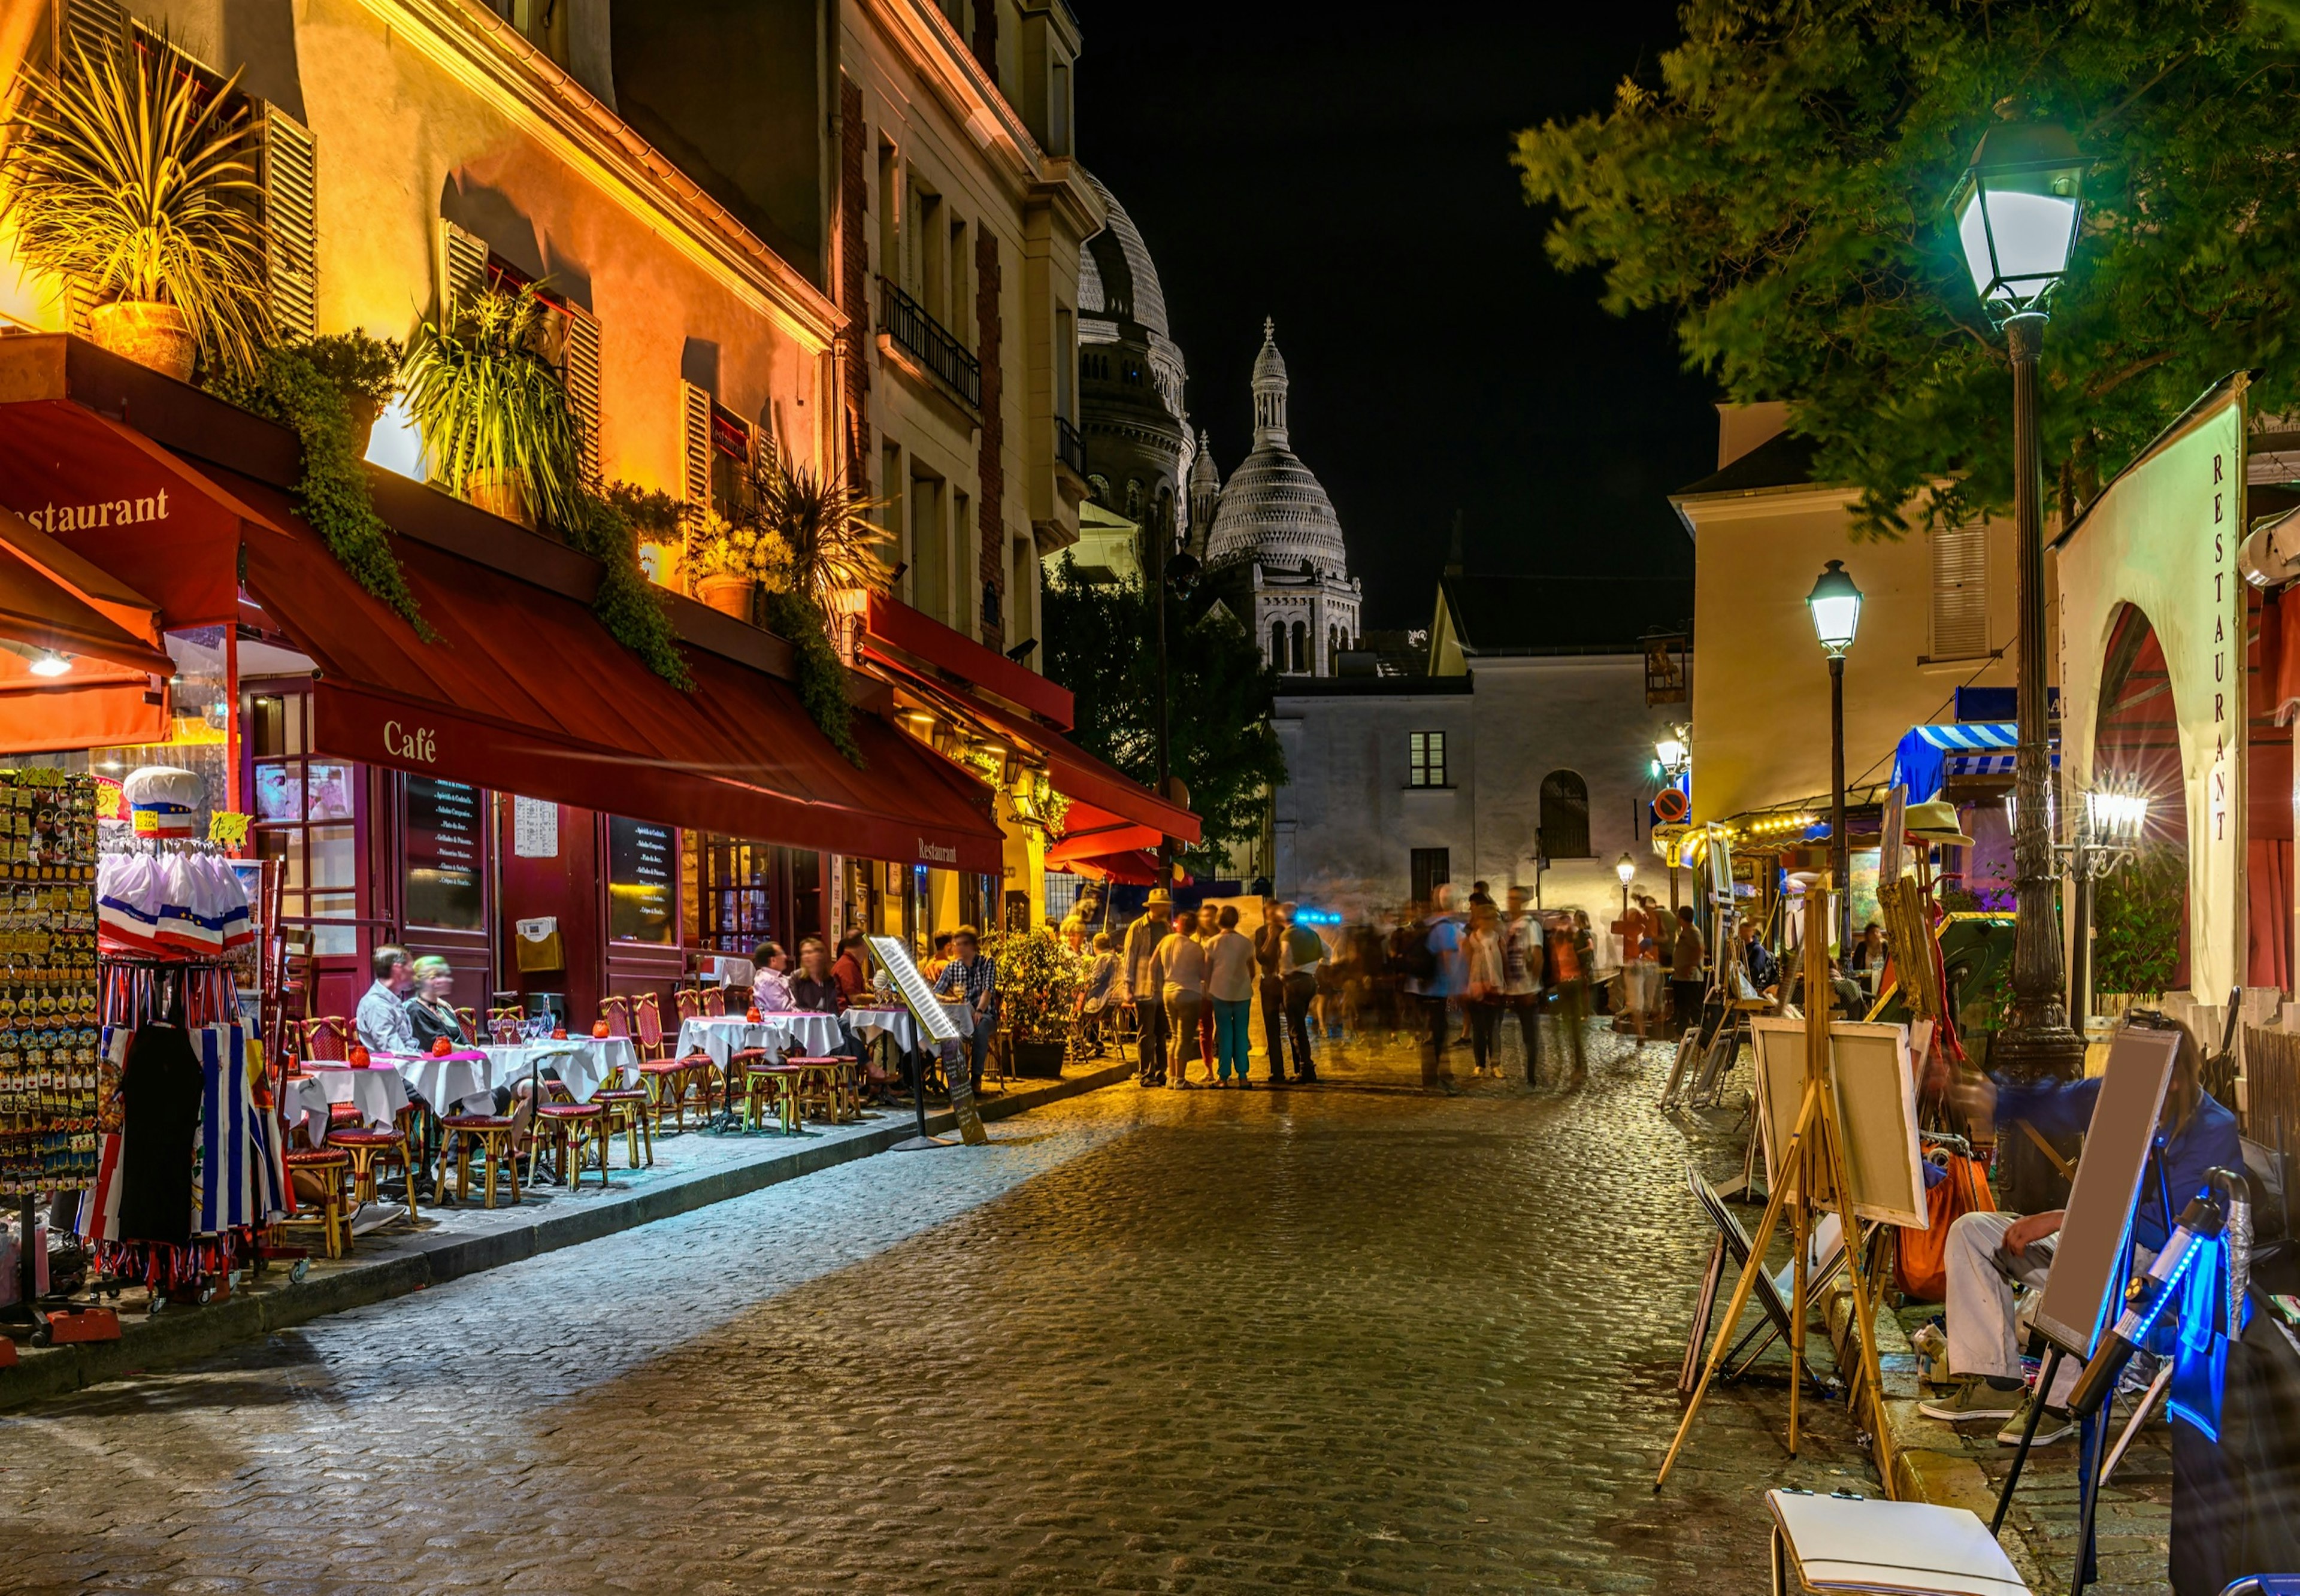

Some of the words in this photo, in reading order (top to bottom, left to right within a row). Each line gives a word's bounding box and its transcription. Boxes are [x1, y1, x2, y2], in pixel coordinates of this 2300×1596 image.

[2213, 454, 2225, 841] RESTAURANT
[384, 720, 436, 764] Café
[918, 837, 957, 863] Restaurant
